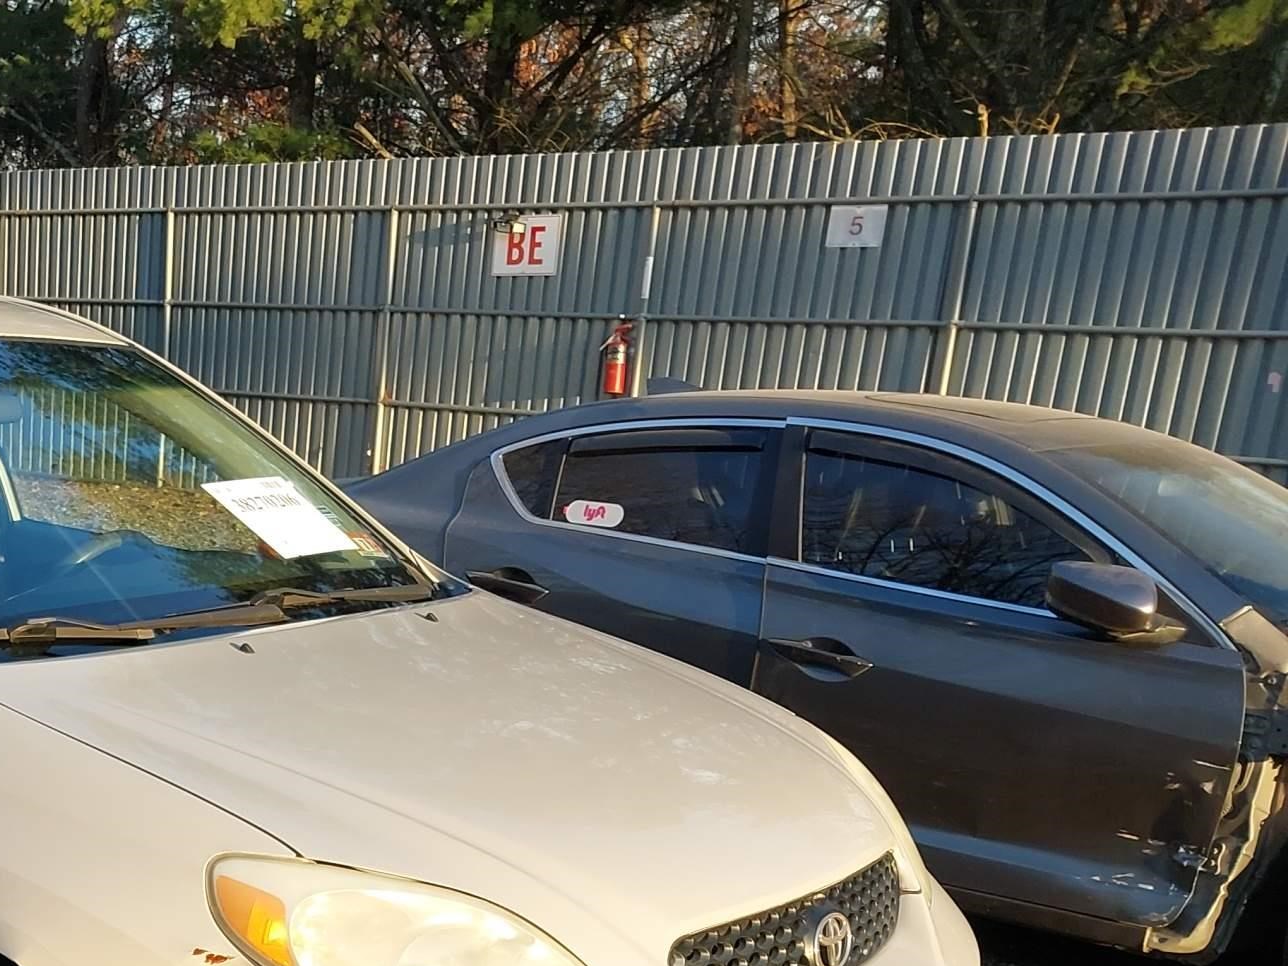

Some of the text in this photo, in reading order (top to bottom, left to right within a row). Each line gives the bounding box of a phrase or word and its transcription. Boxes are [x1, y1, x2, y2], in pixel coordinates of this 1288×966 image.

[849, 216, 864, 236] 5
[506, 226, 546, 266] BE
[231, 493, 302, 513] 38270206
